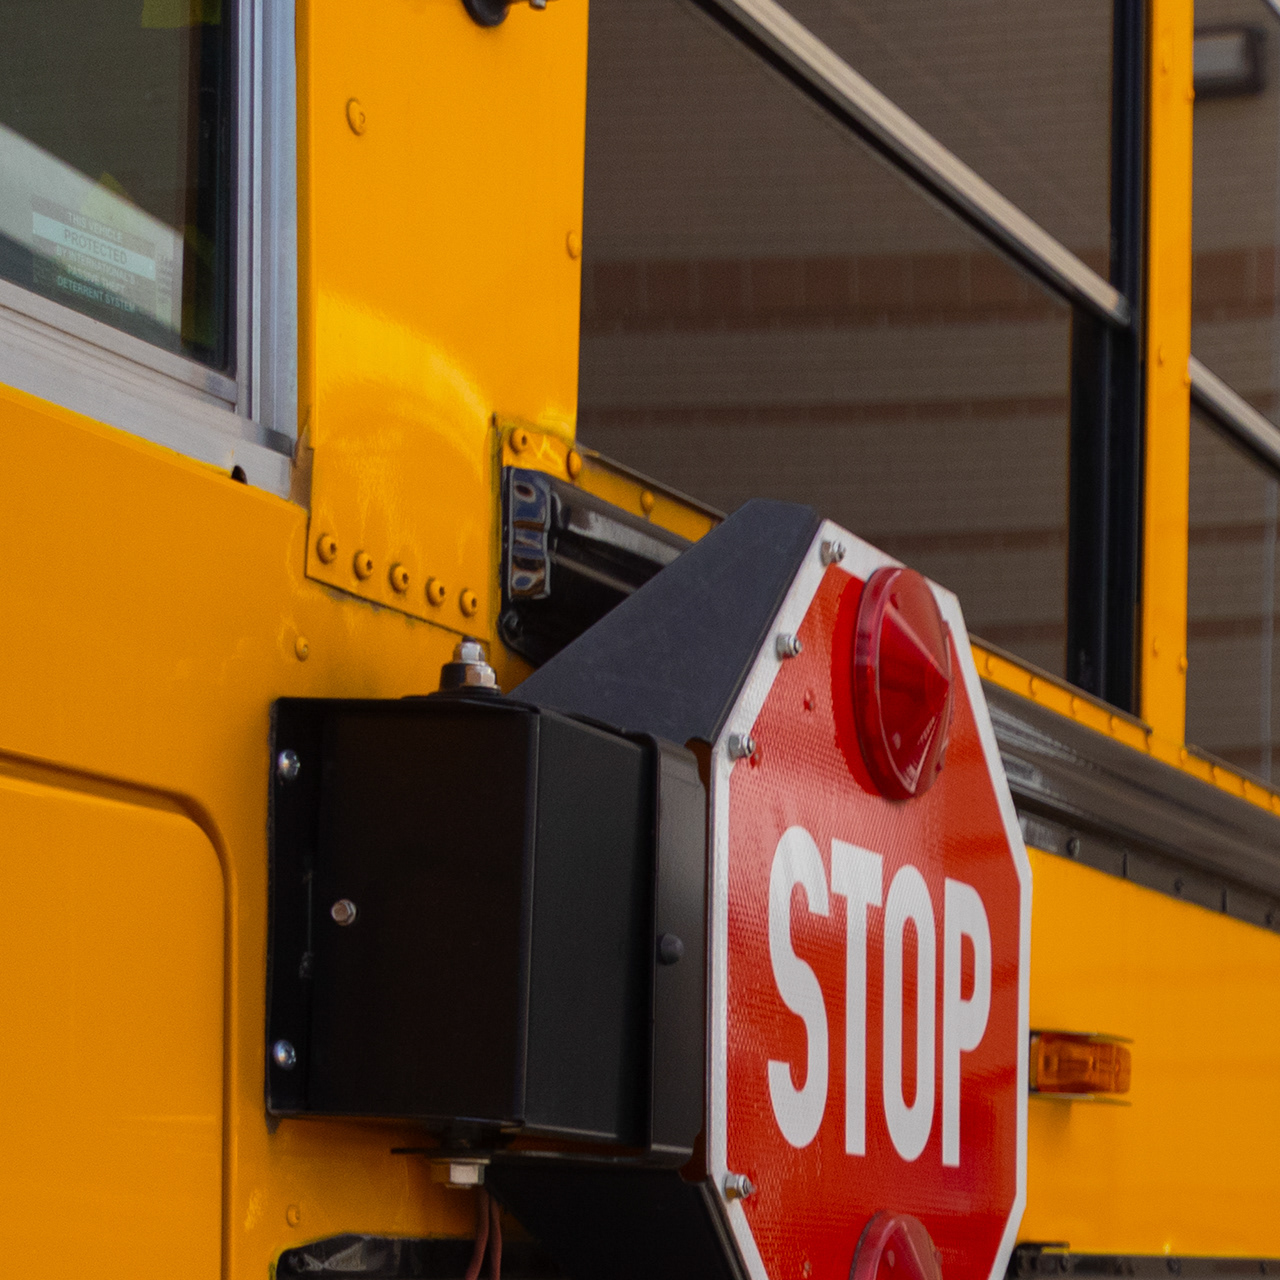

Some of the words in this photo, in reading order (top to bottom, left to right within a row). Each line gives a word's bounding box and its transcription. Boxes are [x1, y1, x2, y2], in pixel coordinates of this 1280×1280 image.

[68, 212, 87, 229] THIS
[89, 219, 123, 242] VEHICLE
[63, 228, 128, 265] PROTECTED
[57, 275, 104, 301] DETERRENT
[768, 825, 992, 1168] STOP
